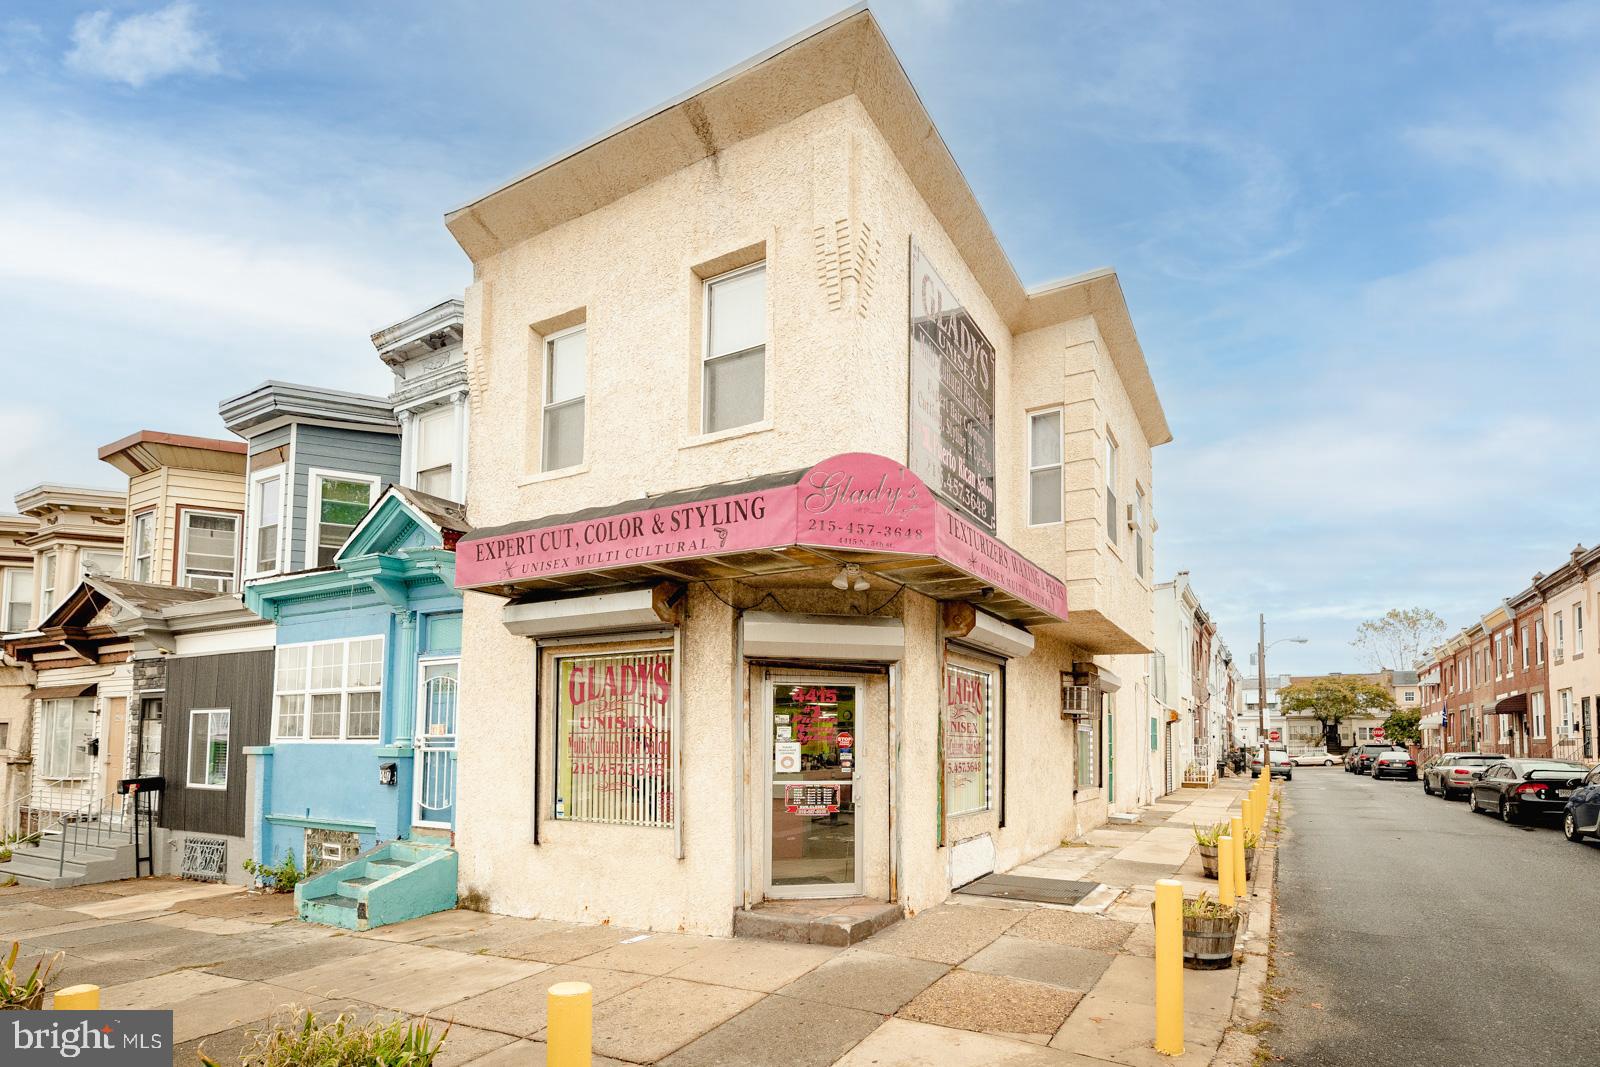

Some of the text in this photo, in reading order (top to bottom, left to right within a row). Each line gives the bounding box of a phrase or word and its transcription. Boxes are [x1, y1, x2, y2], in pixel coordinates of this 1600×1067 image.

[938, 331, 976, 383] UNISEX
[959, 454, 975, 488] Rican
[978, 474, 993, 503] Salon
[804, 471, 918, 515] Glady's
[476, 496, 766, 562] EXPERT CUT, COLOR & STYLING
[808, 518, 923, 540] 215-457-3648
[522, 538, 709, 574] UNISEX MULTI CULTURAL
[981, 563, 1005, 585] UNISEX
[1012, 556, 1040, 587] WAXING
[792, 688, 838, 703] 4415
[580, 716, 655, 731] UNISEX
[950, 721, 978, 734] NISEX
[589, 735, 622, 754] Cultural
[573, 762, 664, 778] 215.457.3648
